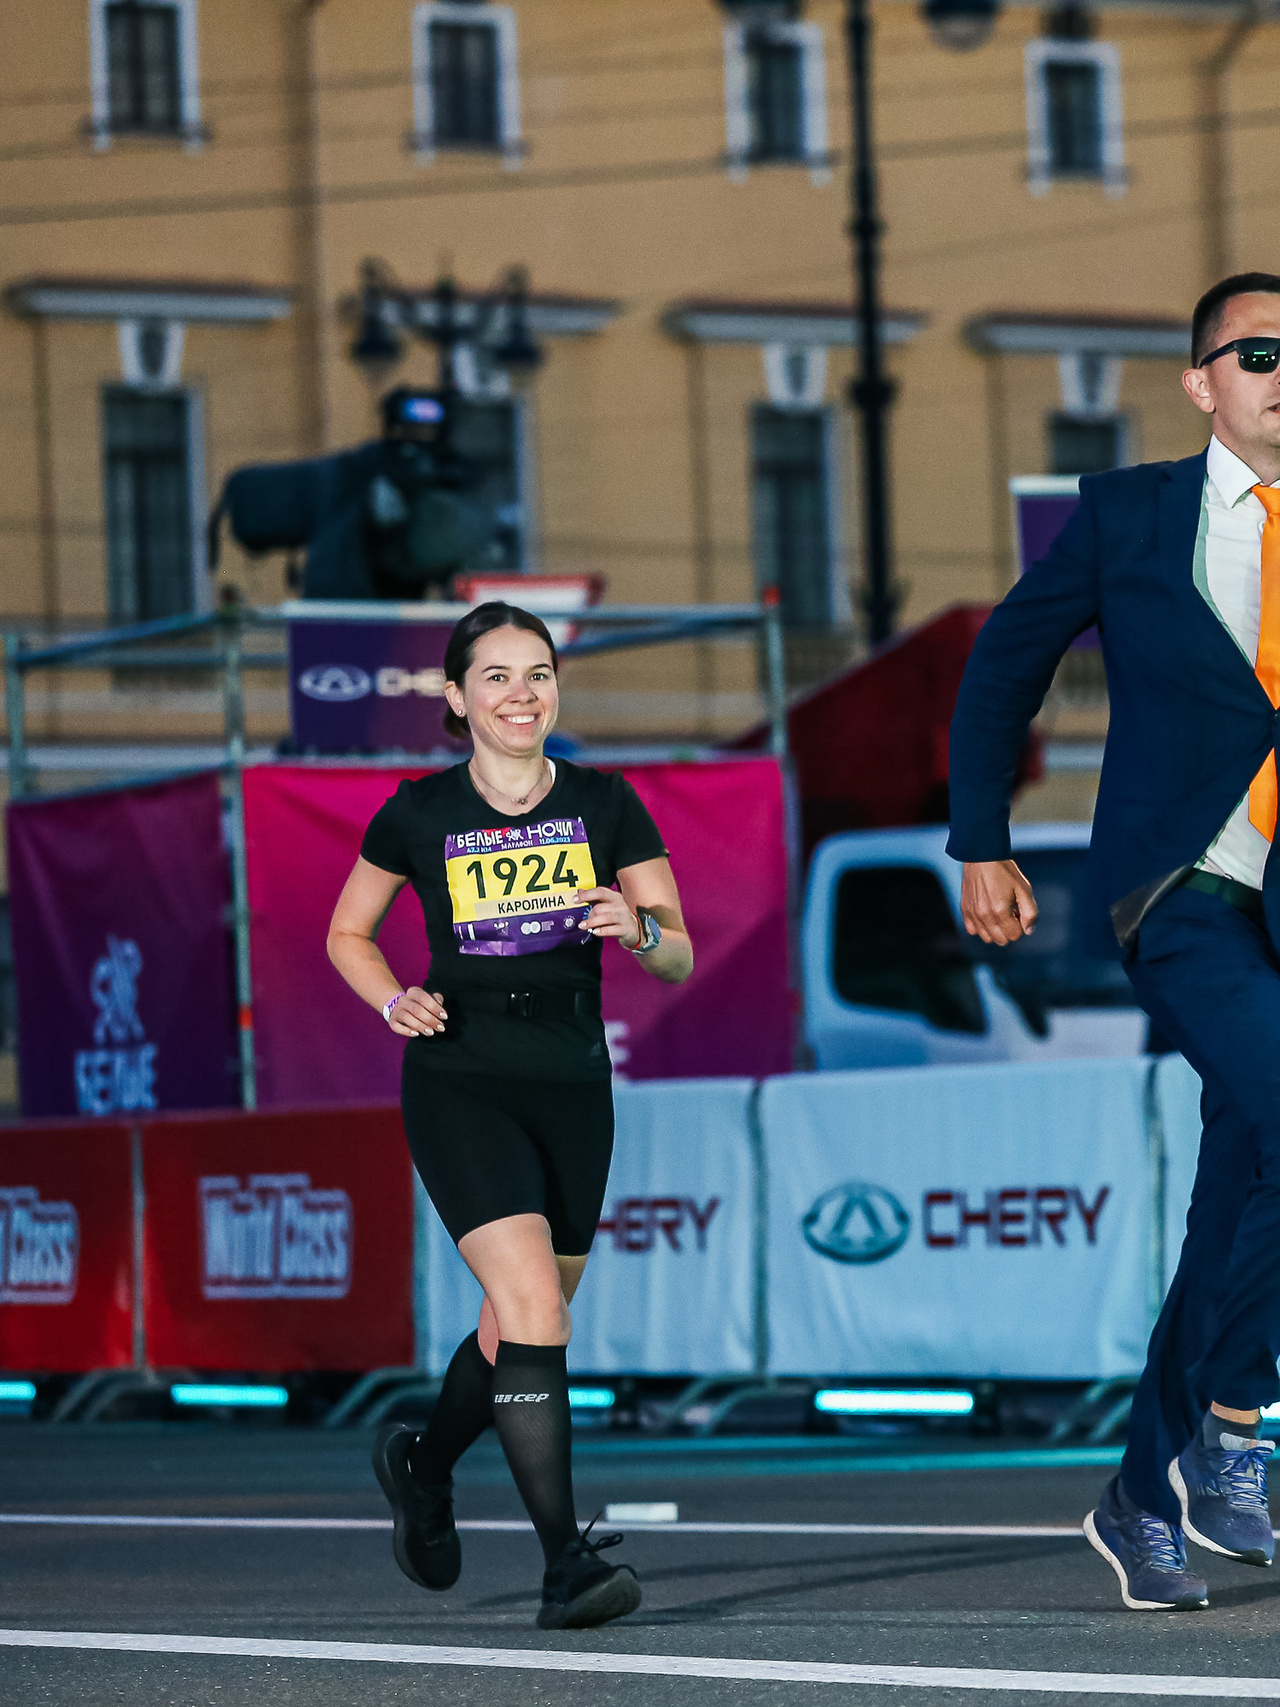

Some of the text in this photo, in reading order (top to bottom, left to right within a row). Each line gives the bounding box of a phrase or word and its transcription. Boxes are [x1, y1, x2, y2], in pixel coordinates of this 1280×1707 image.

[456, 821, 574, 849] БЕЛЫЕ НОЧИ
[466, 850, 579, 899] 1924
[497, 895, 566, 915] КАРОЛИНА
[597, 1196, 719, 1253] HERY
[923, 1185, 1110, 1249] CHERY
